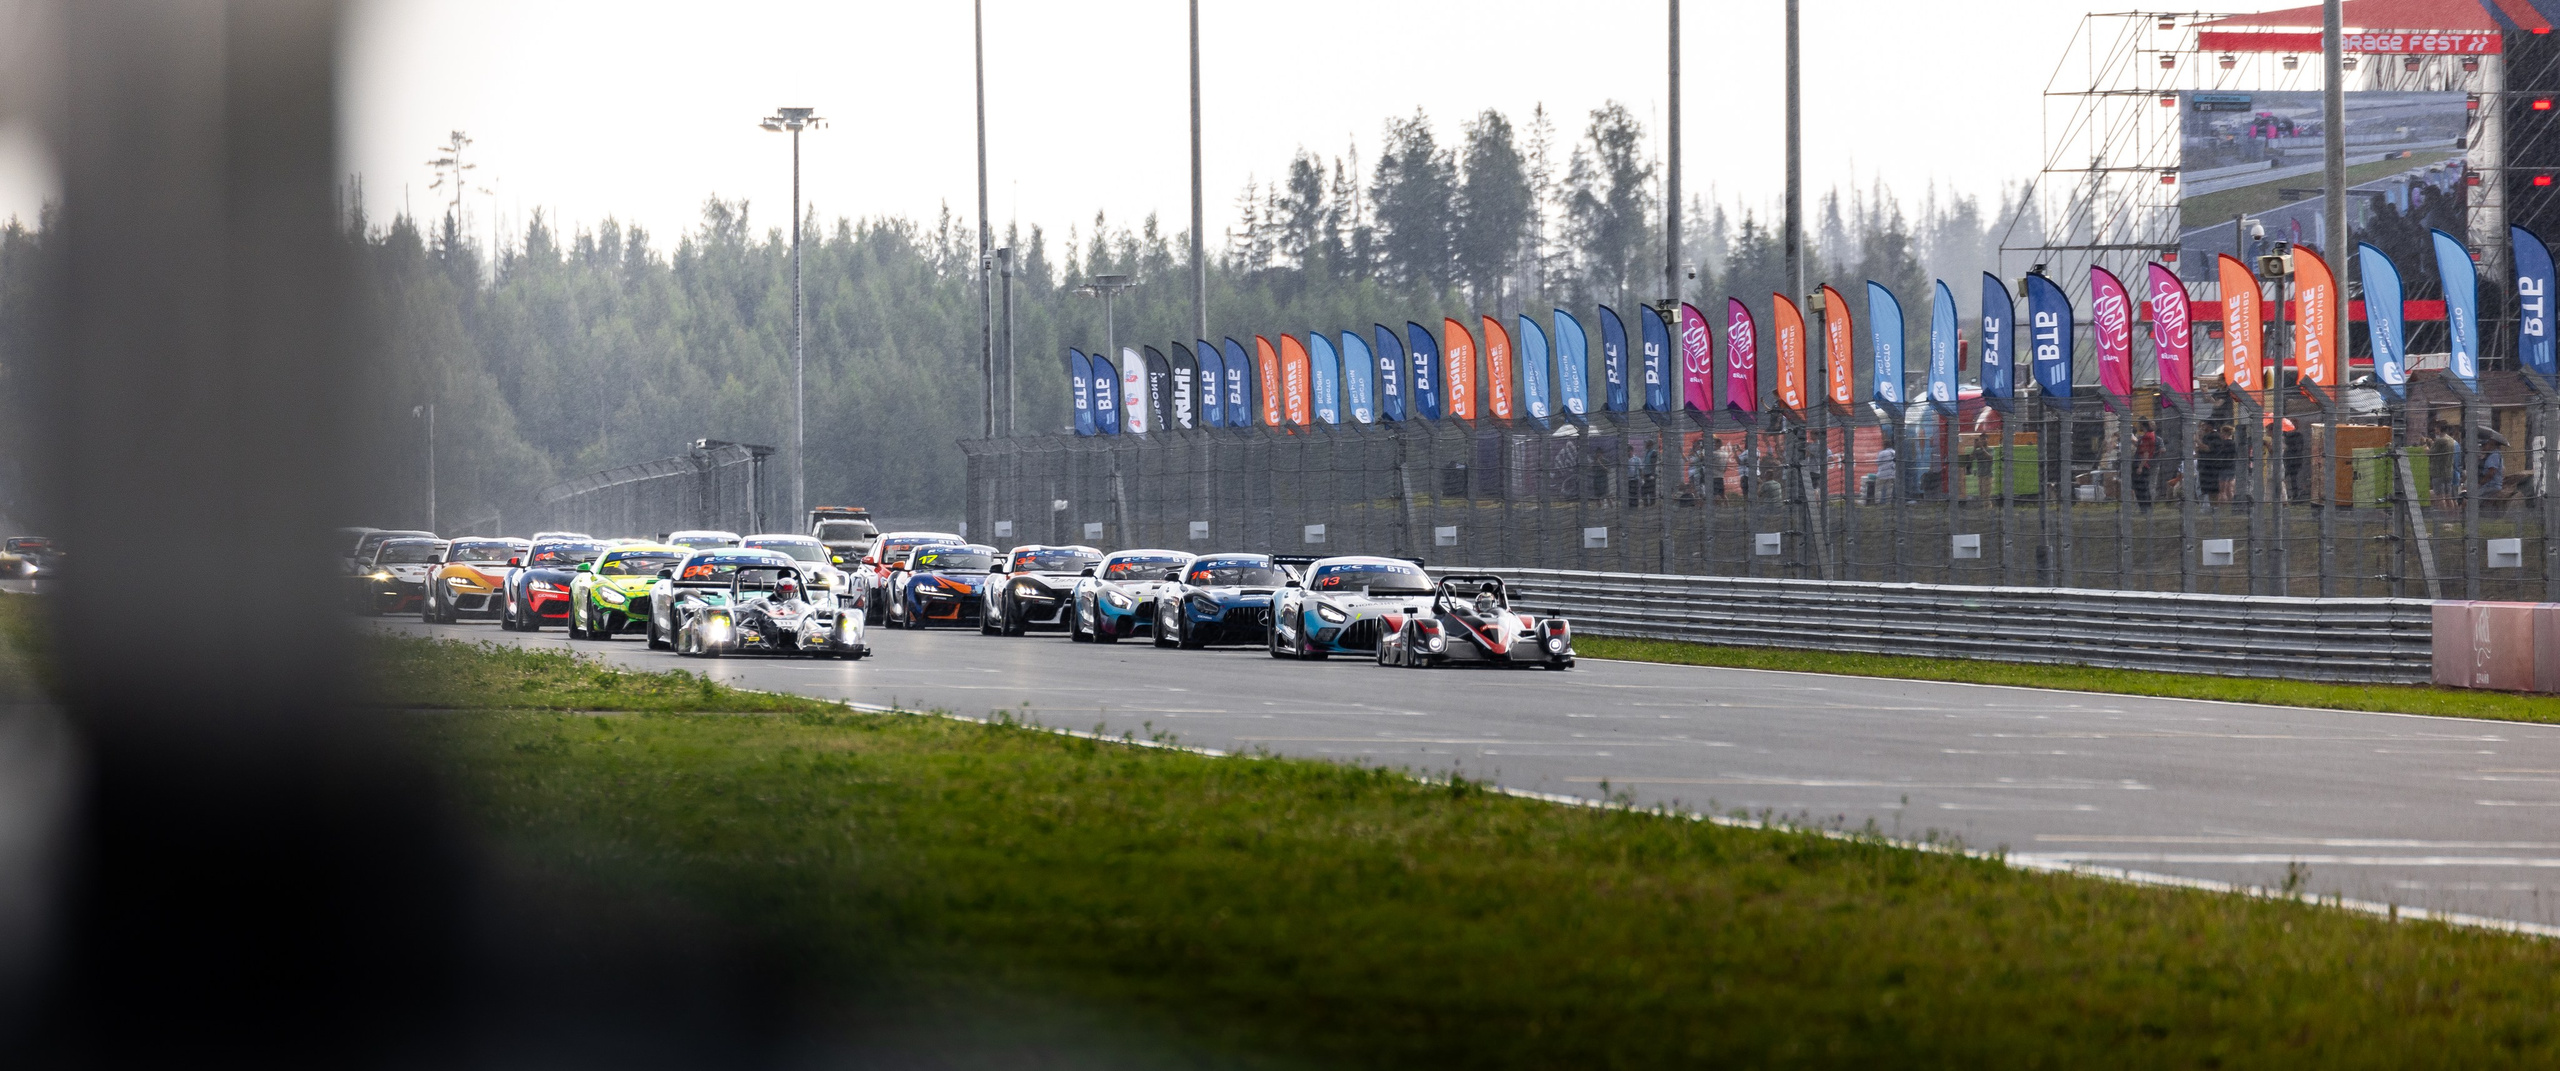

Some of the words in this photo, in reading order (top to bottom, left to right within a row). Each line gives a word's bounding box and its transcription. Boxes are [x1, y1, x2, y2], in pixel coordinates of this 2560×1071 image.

[2321, 35, 2403, 51] ARAGE
[918, 555, 938, 564] 17
[1074, 551, 1095, 559] ВТБ
[604, 560, 621, 569] 4
[761, 557, 785, 566] ВТБ
[1015, 557, 1037, 565] 37
[683, 565, 714, 578] 88
[1387, 565, 1411, 575] ВТБ
[1321, 576, 1341, 586] 13
